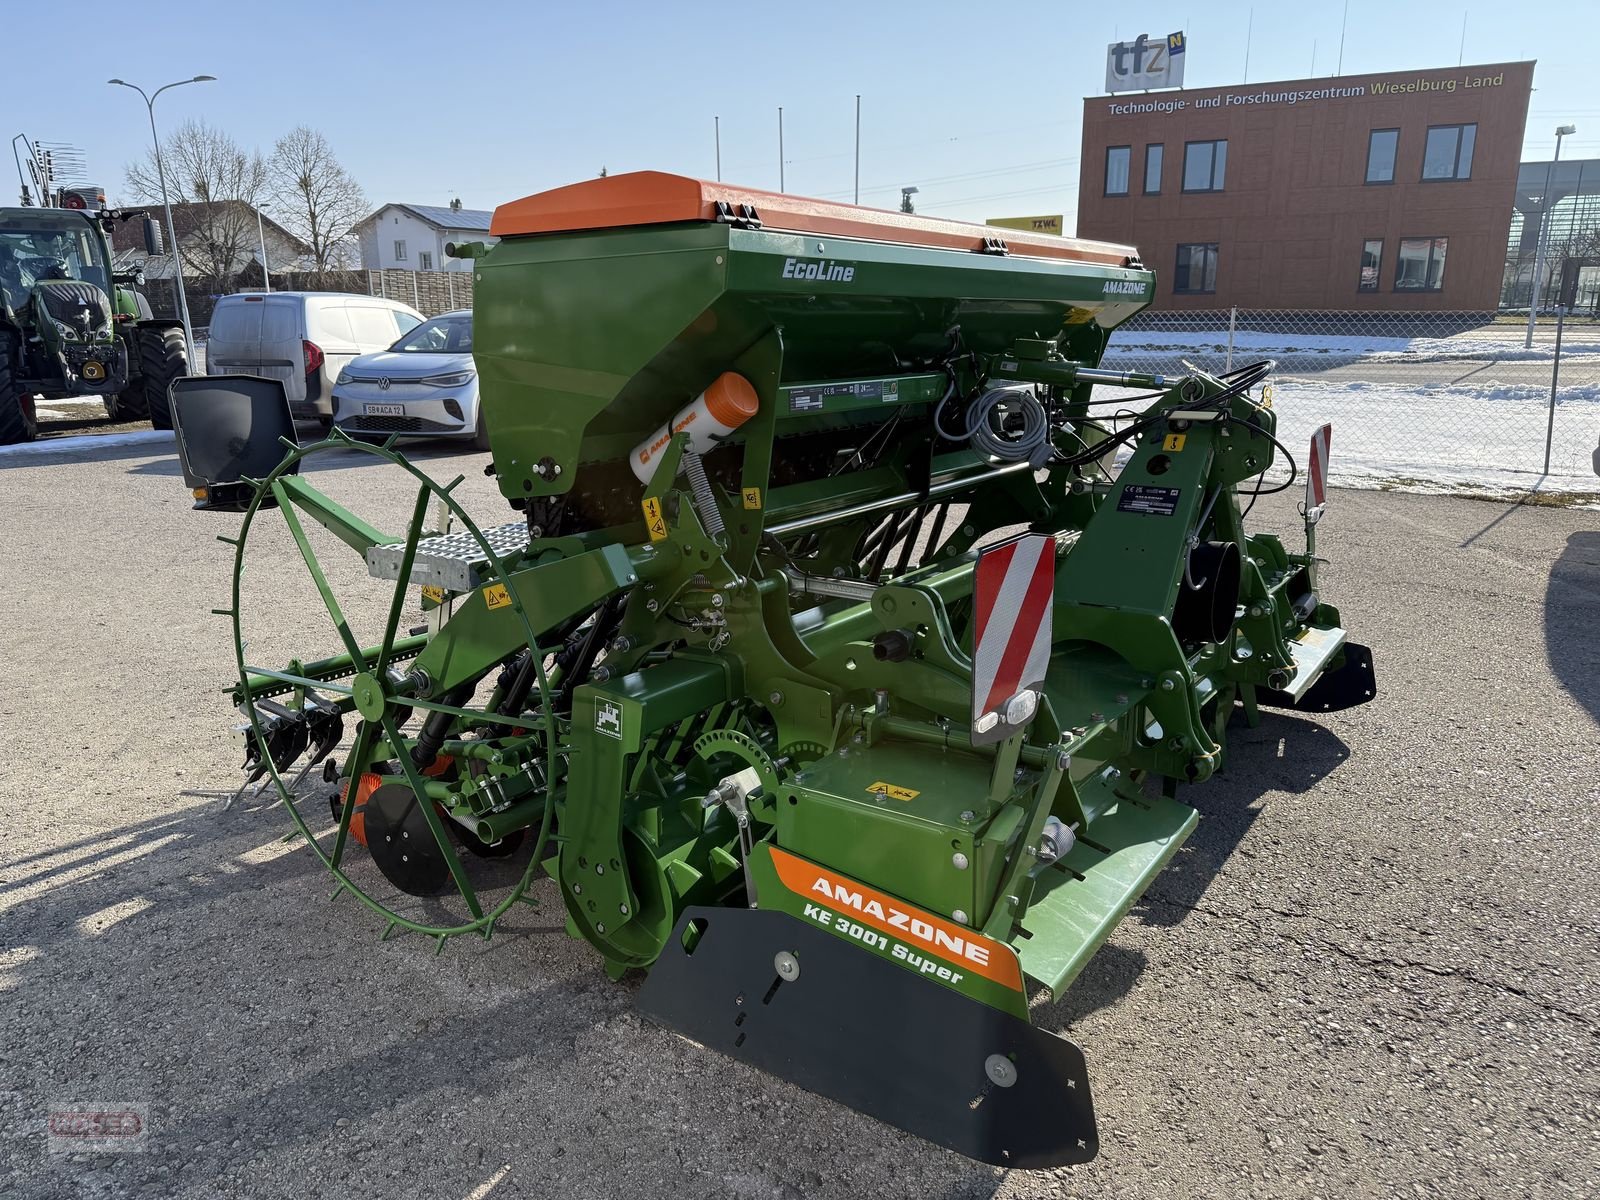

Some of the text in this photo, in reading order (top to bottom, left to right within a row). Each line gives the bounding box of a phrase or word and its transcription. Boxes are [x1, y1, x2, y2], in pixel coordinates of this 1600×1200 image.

[1111, 34, 1166, 76] tfz
[1108, 72, 1504, 115] Technologie- und Forschungszentrum Wieselburg-Land
[782, 257, 855, 282] EcoLine
[1102, 280, 1146, 295] AMAZONE
[650, 411, 697, 455] AMAONE
[811, 877, 990, 967] AMAZONE
[803, 903, 964, 985] KE 3001 Super
